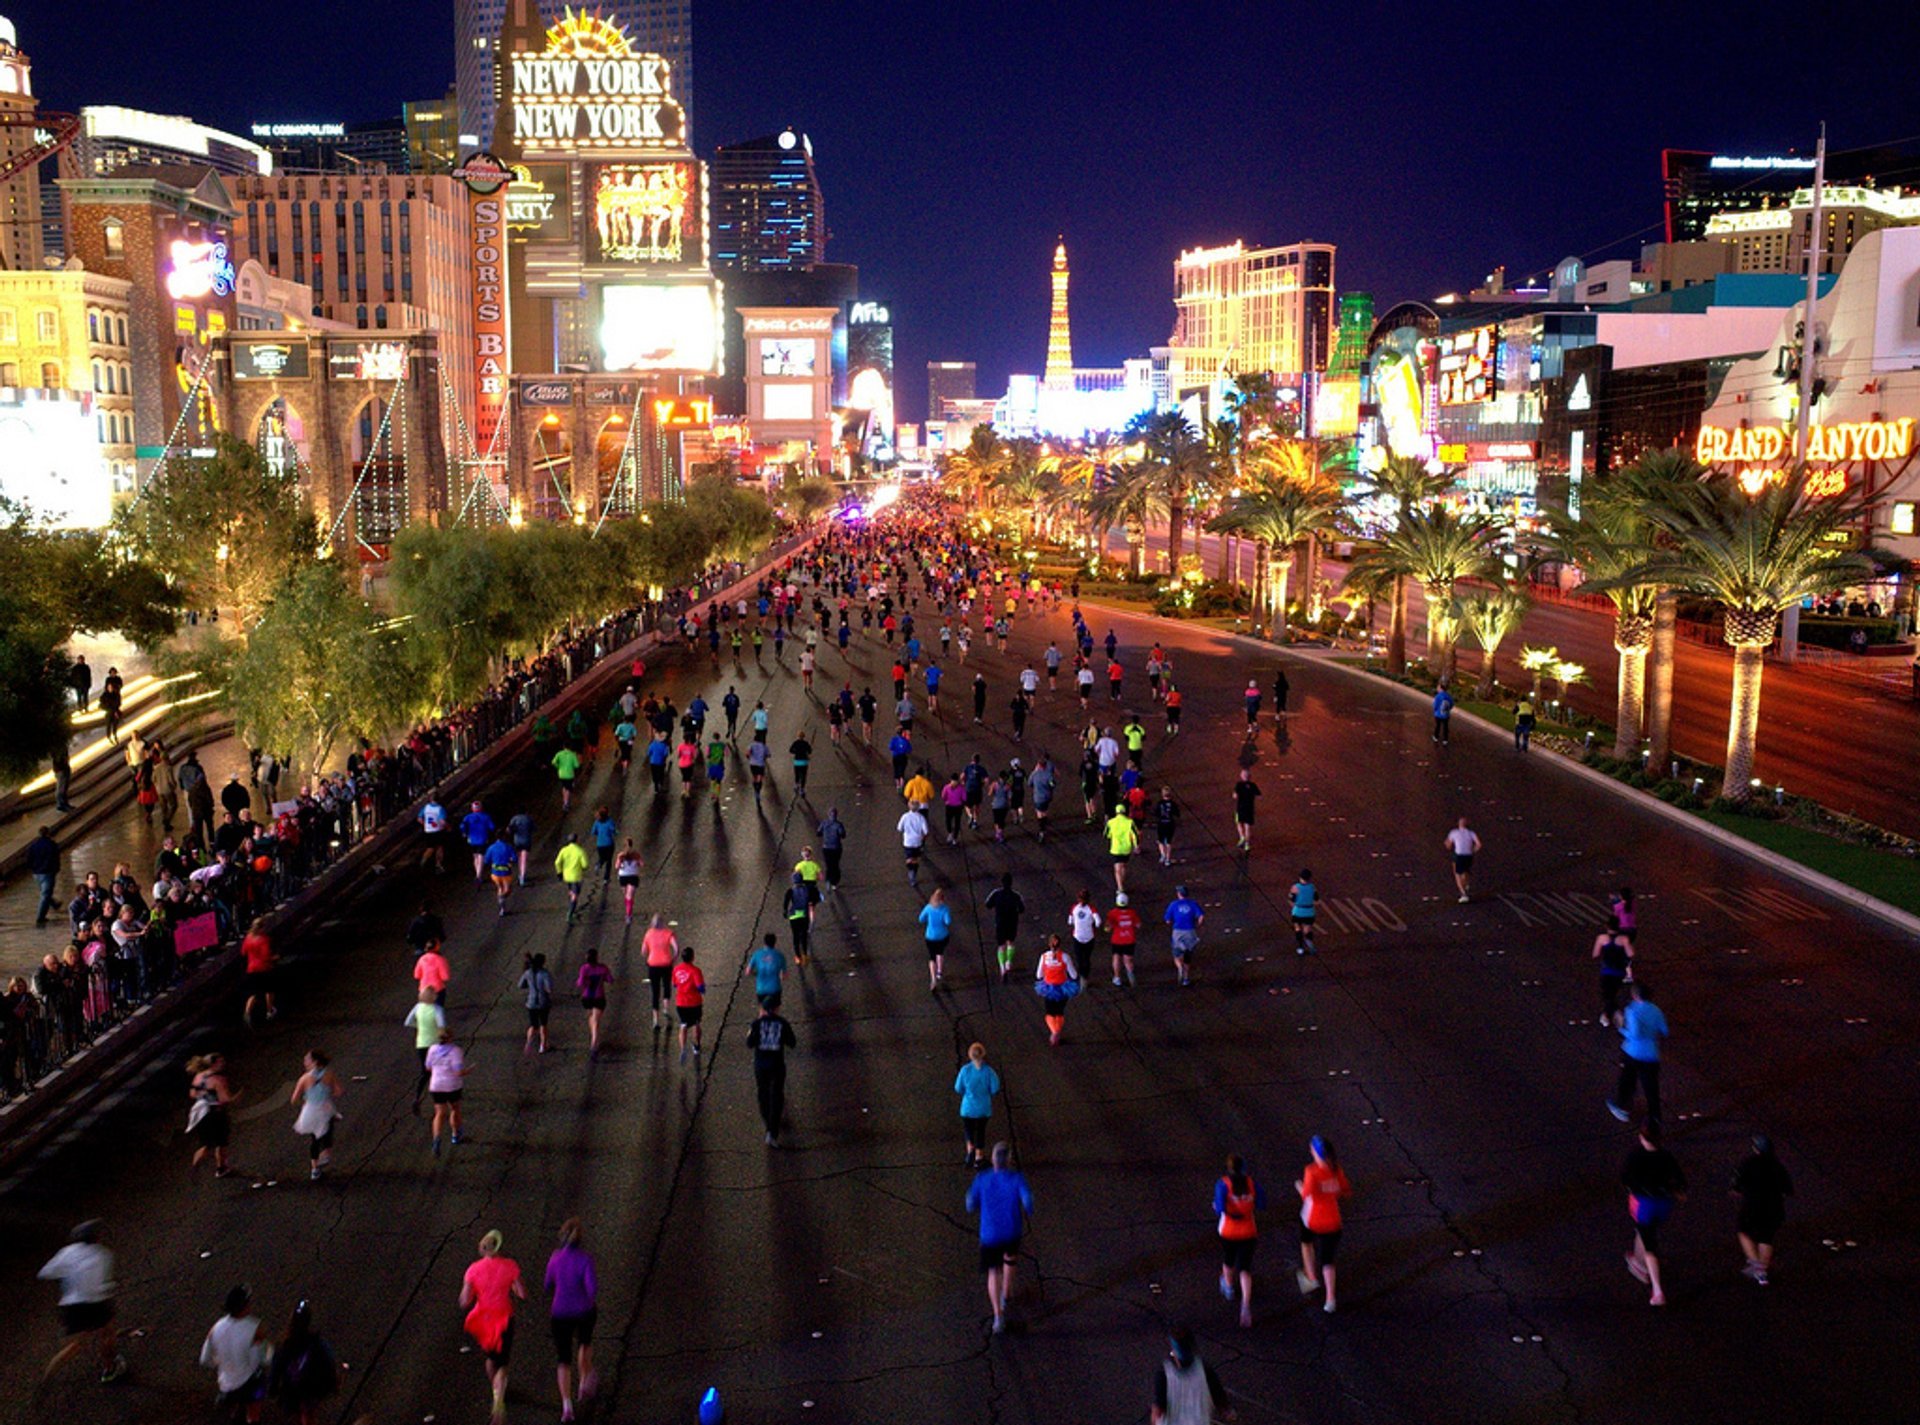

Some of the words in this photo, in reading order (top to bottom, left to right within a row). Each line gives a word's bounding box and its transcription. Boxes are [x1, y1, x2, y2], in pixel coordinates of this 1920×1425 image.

[513, 60, 578, 94] NEW
[583, 60, 663, 94] YORK
[251, 124, 270, 136] THE
[272, 123, 344, 136] COSMOPOLITAN
[513, 104, 578, 138] NEW
[584, 104, 664, 138] YORK
[504, 202, 555, 220] ARTY.
[475, 202, 500, 321] SPORTS
[478, 334, 503, 394] BAR
[1697, 426, 1785, 464] GRAND
